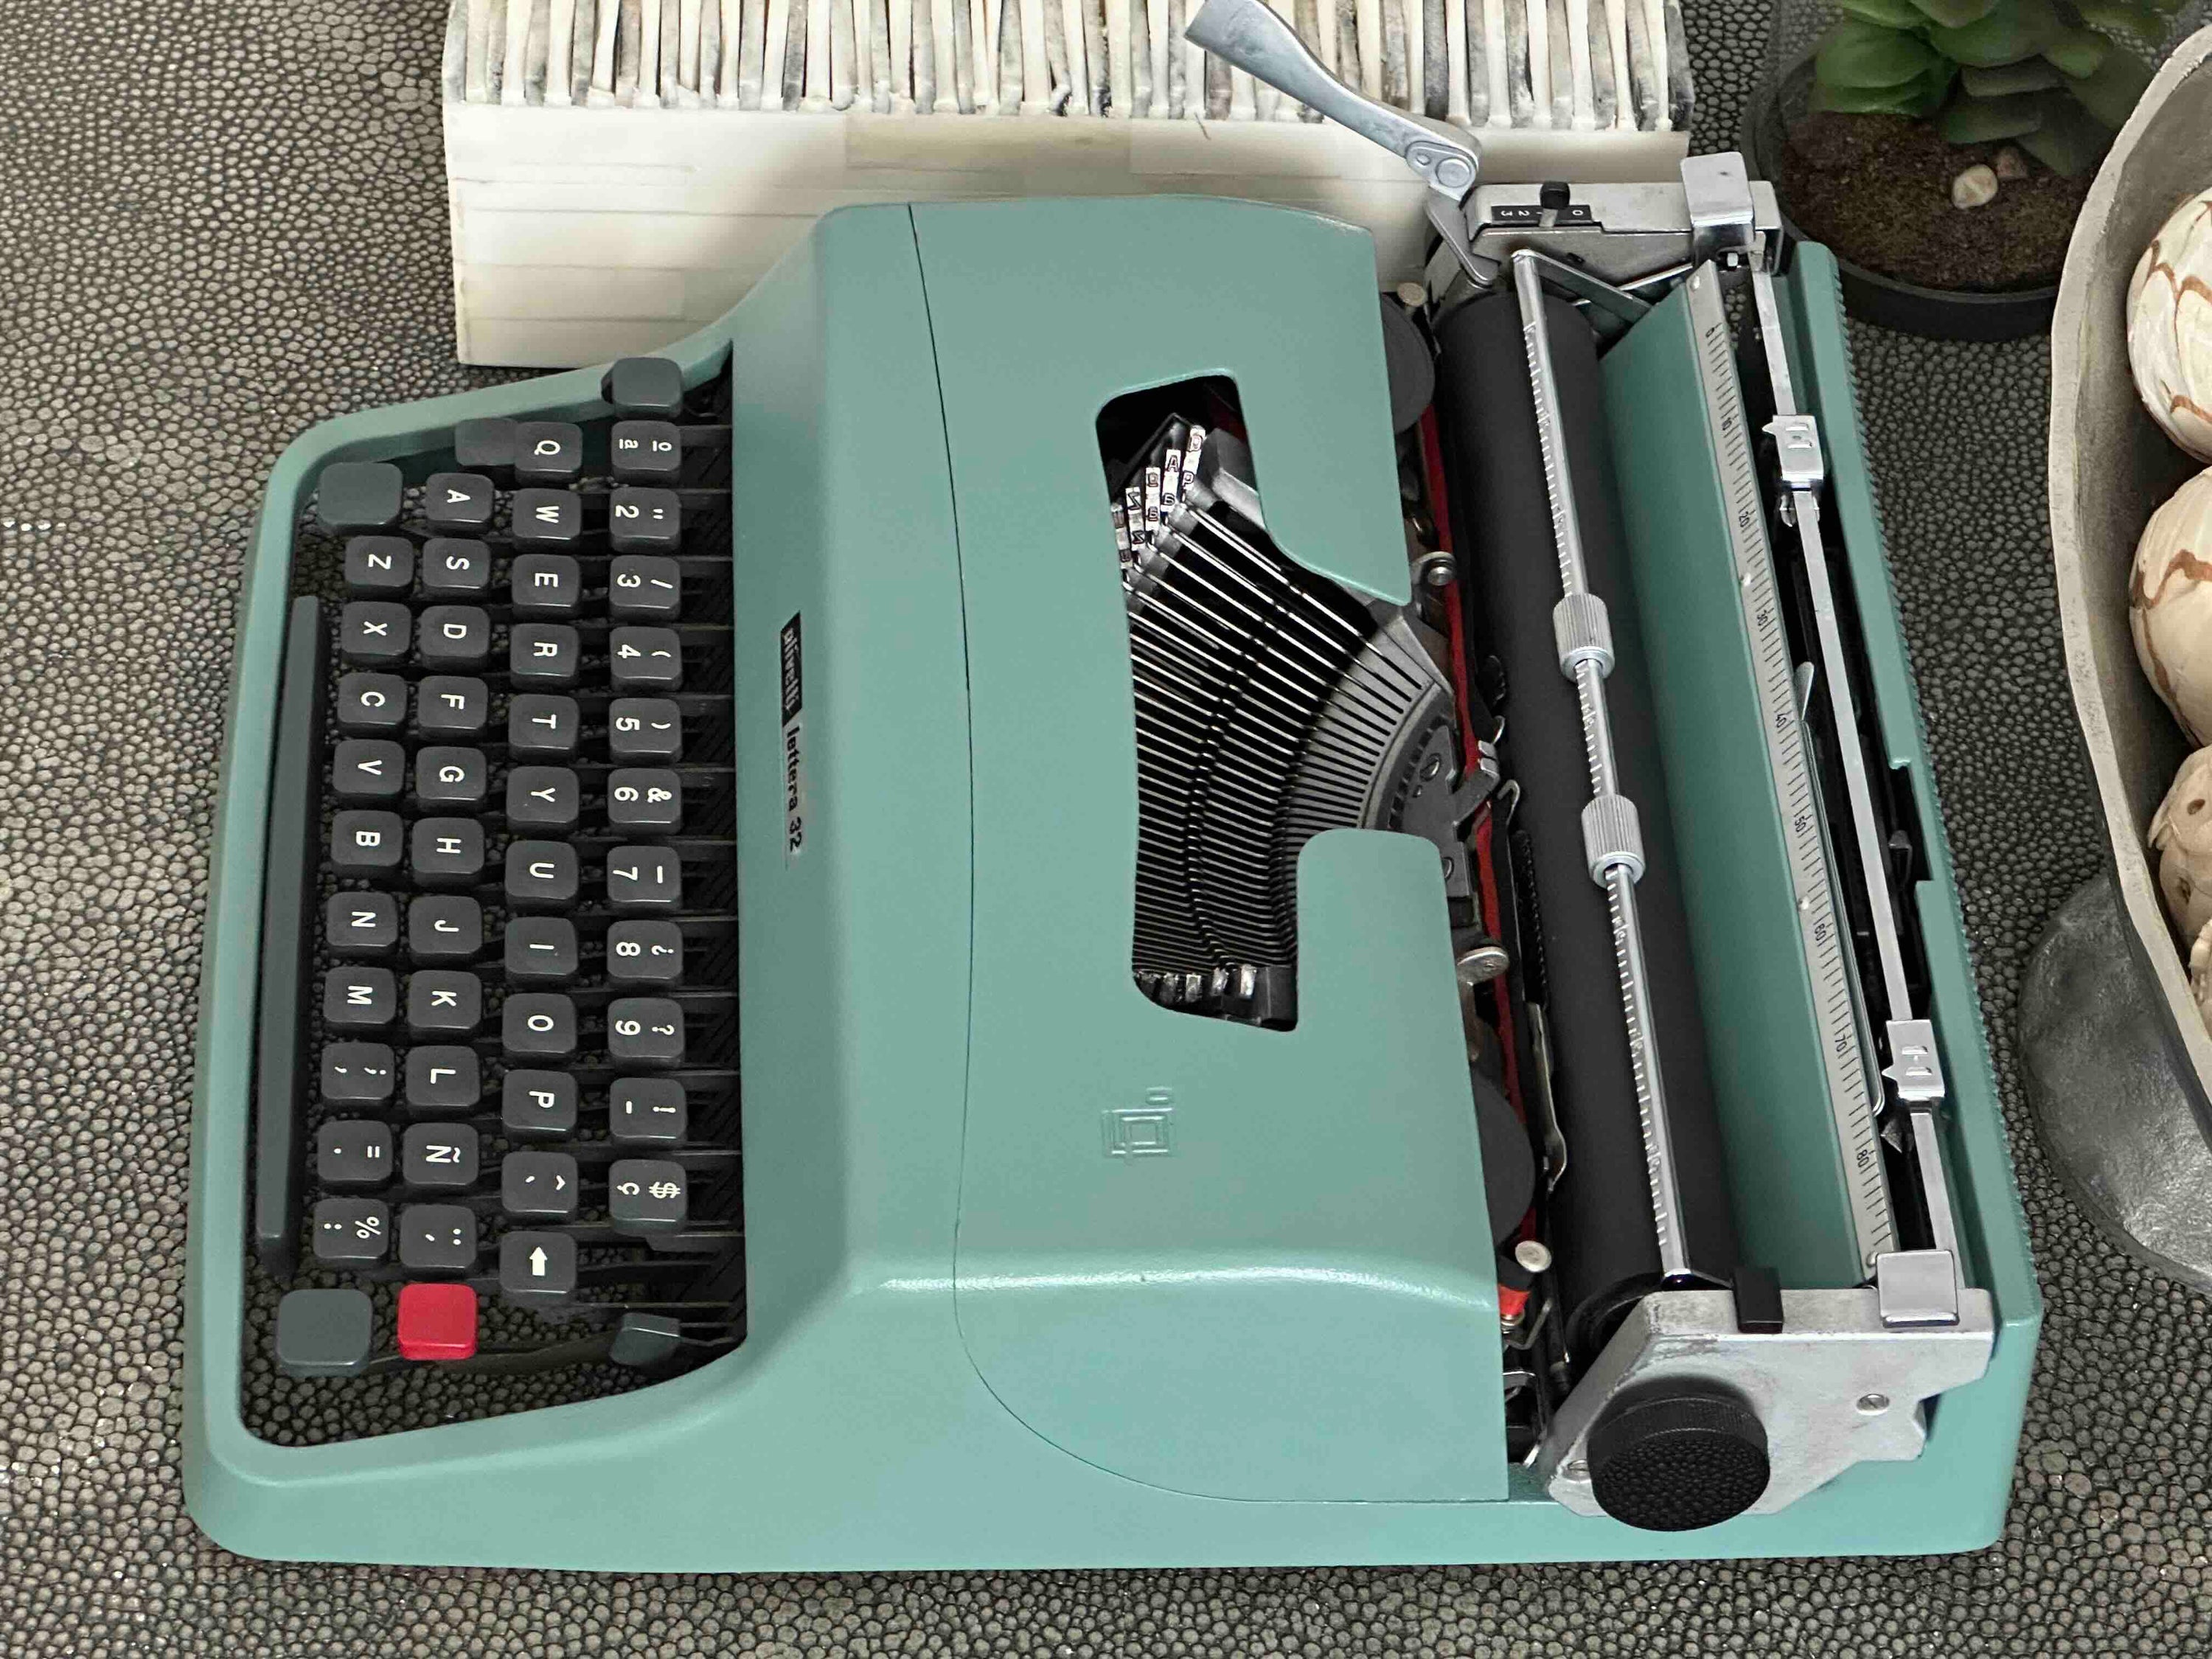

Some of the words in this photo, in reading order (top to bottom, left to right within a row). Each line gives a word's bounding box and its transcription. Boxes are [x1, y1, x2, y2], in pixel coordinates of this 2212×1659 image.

[1518, 209, 1530, 218] 2
[534, 439, 561, 456] Q
[446, 489, 471, 504] A
[535, 506, 560, 524] W
[615, 504, 640, 518] 2
[367, 554, 392, 570] Z
[445, 555, 470, 570] S
[535, 572, 559, 588] E
[616, 574, 641, 588] 3
[650, 579, 673, 589] /
[363, 621, 388, 636] X
[443, 623, 467, 639] D
[533, 641, 558, 657] R
[617, 644, 641, 659] 4
[783, 627, 800, 710] olivetti
[361, 691, 386, 707] C
[440, 694, 465, 710] F
[532, 714, 557, 729] T
[615, 717, 640, 731] 5
[357, 759, 383, 776] V
[439, 765, 465, 783] G
[787, 726, 800, 812] lettera
[530, 787, 556, 802] Y
[613, 787, 639, 801] 6
[647, 787, 672, 804] &
[355, 830, 381, 846] B
[789, 816, 802, 852] 32
[1739, 510, 1750, 528] 20
[1756, 610, 1769, 627] 30
[1775, 714, 1787, 728] 40
[1794, 815, 1807, 832] 50
[1814, 922, 1827, 942] 60
[1834, 1034, 1848, 1053] 70
[1856, 1149, 1869, 1168] 80
[436, 838, 462, 854] H
[529, 862, 555, 879] U
[612, 866, 639, 881] 7
[351, 911, 376, 928] N
[434, 919, 459, 932] J
[616, 942, 641, 956] 8
[651, 945, 675, 956] ¿
[347, 985, 373, 1005] M
[431, 990, 457, 1006] K
[615, 1020, 641, 1036] 9
[651, 1024, 675, 1036] ?
[430, 1068, 456, 1085] L
[529, 1091, 555, 1108] P
[425, 1145, 461, 1164] Ñ
[648, 1181, 681, 1199] $
[355, 1216, 381, 1239] %
